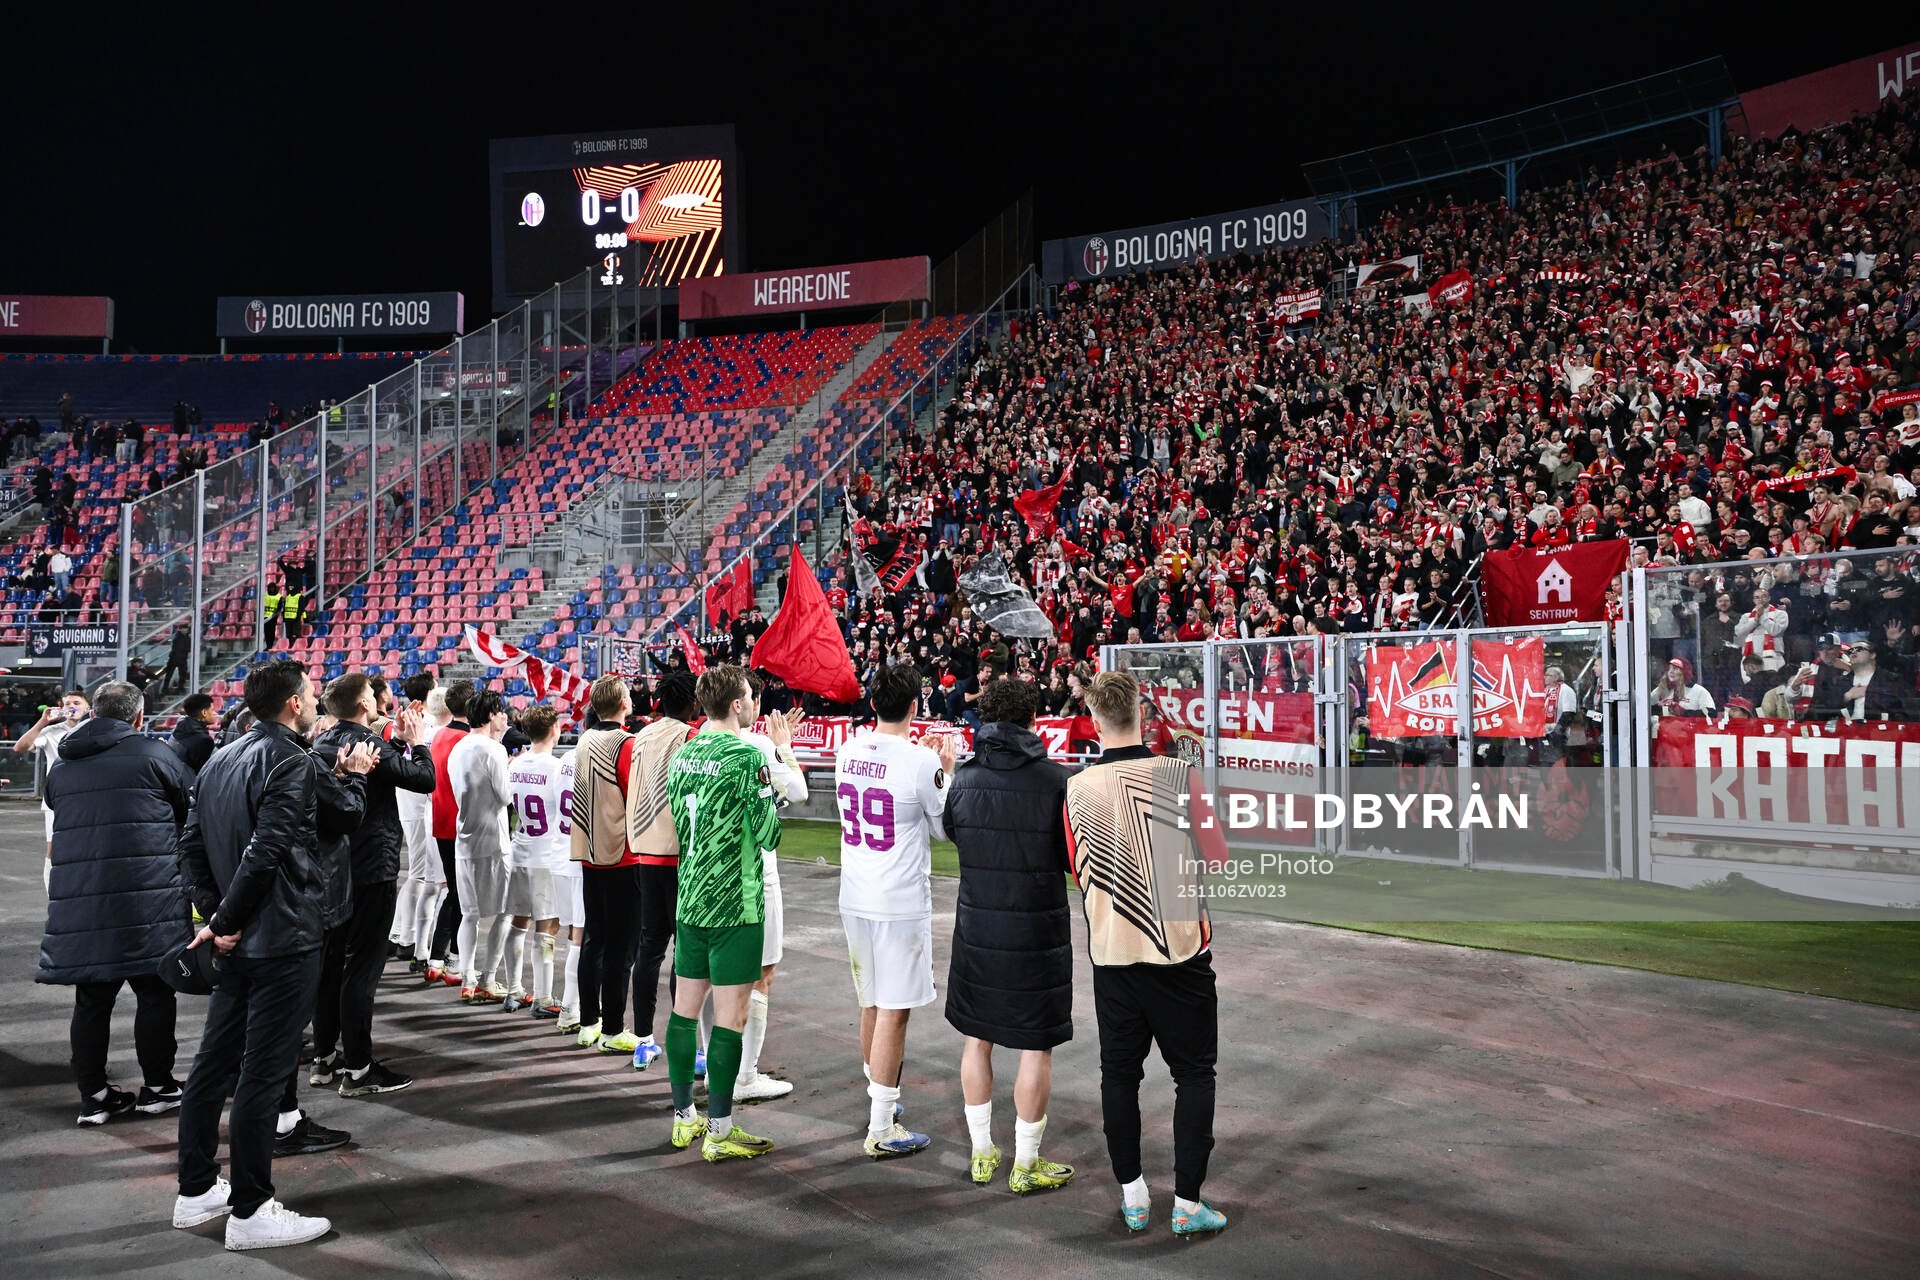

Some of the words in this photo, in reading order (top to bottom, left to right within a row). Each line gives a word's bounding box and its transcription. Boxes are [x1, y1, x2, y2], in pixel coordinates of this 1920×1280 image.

[582, 140, 617, 153] BOLOGNA
[618, 139, 629, 151] FC
[630, 138, 648, 150] 1909
[1114, 225, 1212, 268] BOLOGNA
[1222, 219, 1247, 252] FC
[1253, 208, 1308, 247] 1909
[753, 270, 851, 306] WEAREONE
[1441, 280, 1471, 301] RANN
[271, 303, 354, 329] BOLOGNA
[361, 302, 384, 327] FC
[387, 300, 431, 327] 1909
[1529, 608, 1578, 620] SENTRUM
[53, 628, 105, 644] SAVIGNANO
[1418, 693, 1487, 709] BRAN
[842, 759, 887, 780] LÆGREID
[1217, 755, 1314, 778] BERGENSIS
[685, 793, 697, 858] 1
[837, 782, 896, 852] 39
